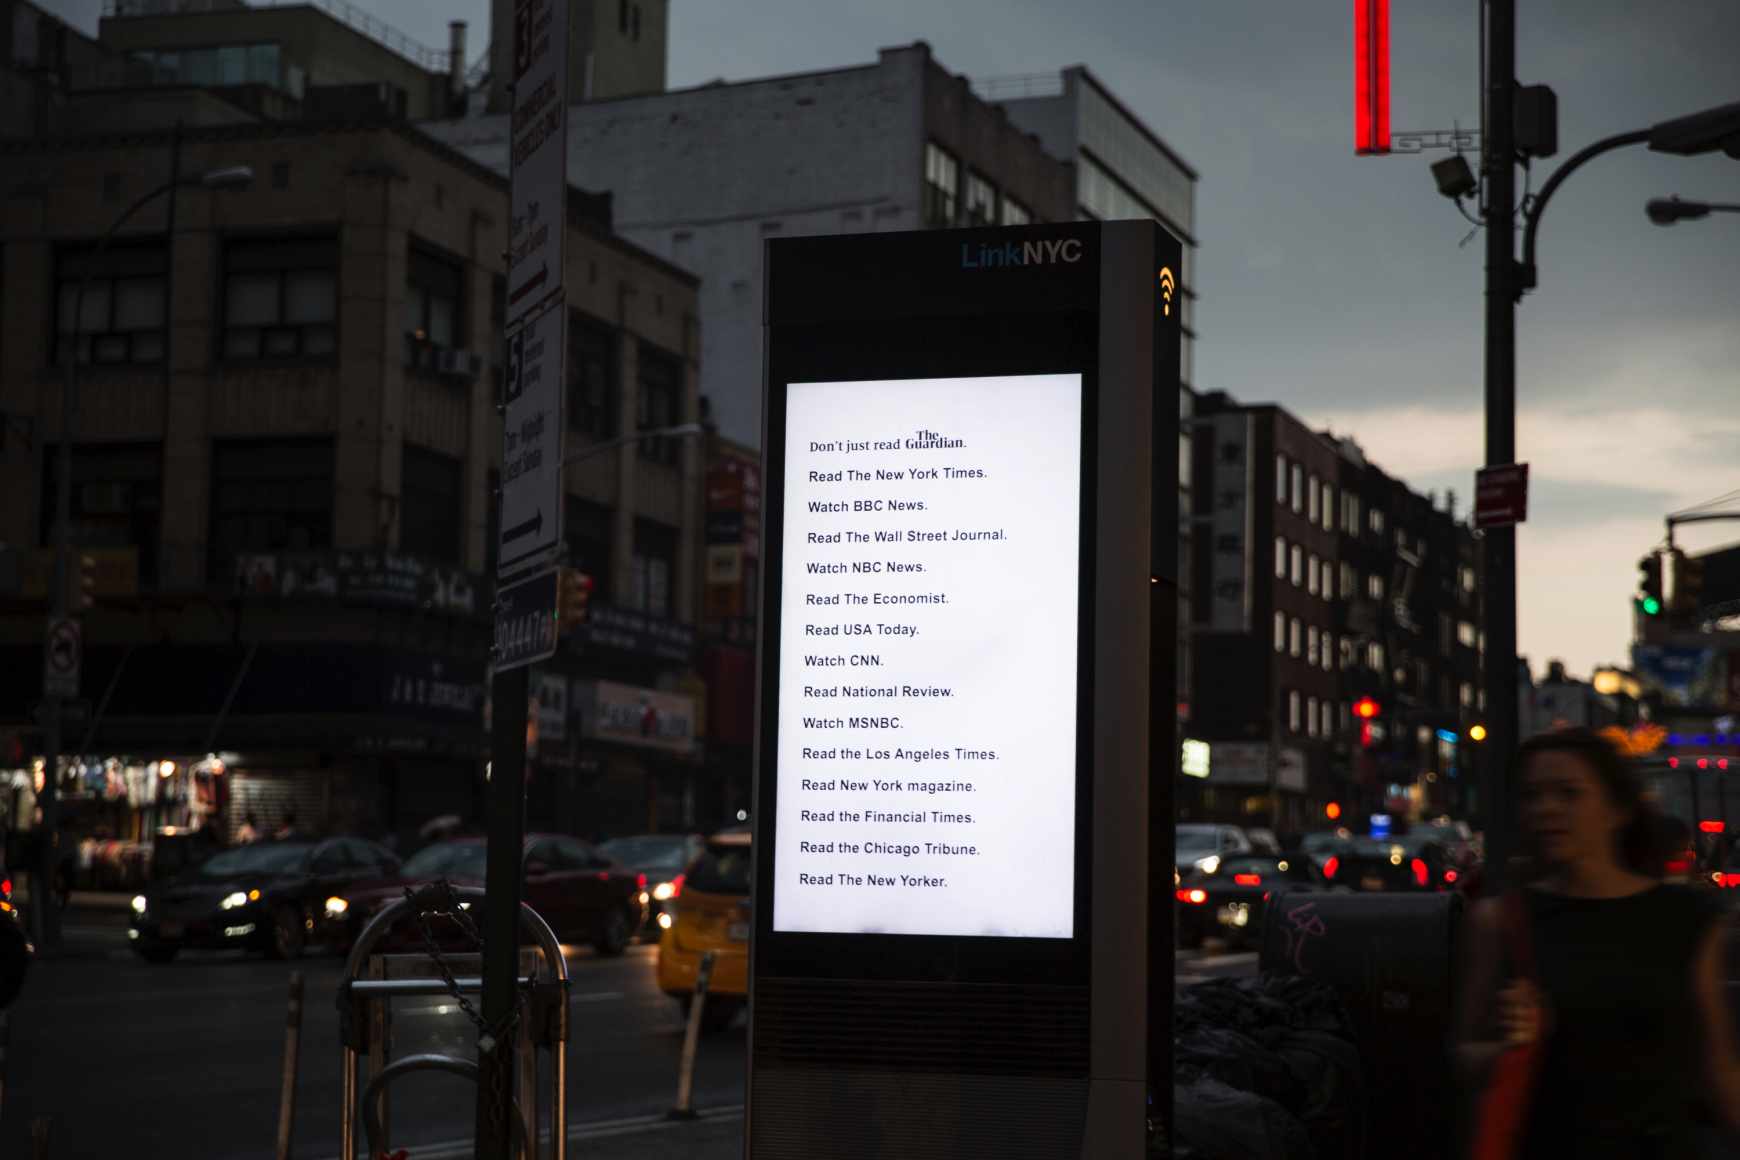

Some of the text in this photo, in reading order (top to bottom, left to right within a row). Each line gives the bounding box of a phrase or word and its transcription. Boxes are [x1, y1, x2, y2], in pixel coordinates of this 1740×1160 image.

[960, 239, 1082, 269] LinkNYC
[916, 430, 939, 441] The
[809, 437, 967, 454] Don't just read Guardian.
[809, 467, 988, 482] Read The New York Times.
[808, 499, 928, 512] Watch BBC News.
[808, 528, 1007, 544] Read The Wall Street Journal.
[806, 561, 926, 574] Watch NBC News.
[806, 592, 949, 605] Read The Economist.
[805, 624, 920, 637] Read USA Today.
[804, 655, 884, 666] Watch CNN.
[804, 685, 954, 697] Read National Review.
[803, 717, 904, 728] Watch MSNBC.
[802, 748, 999, 763] Read the Los Angeles Times.
[802, 779, 976, 794] Read New York magazine.
[801, 810, 976, 823] Read the Financial Times.
[800, 841, 981, 857] Read the Chicago Tribune.
[799, 872, 948, 888] Read The New Yorker.
